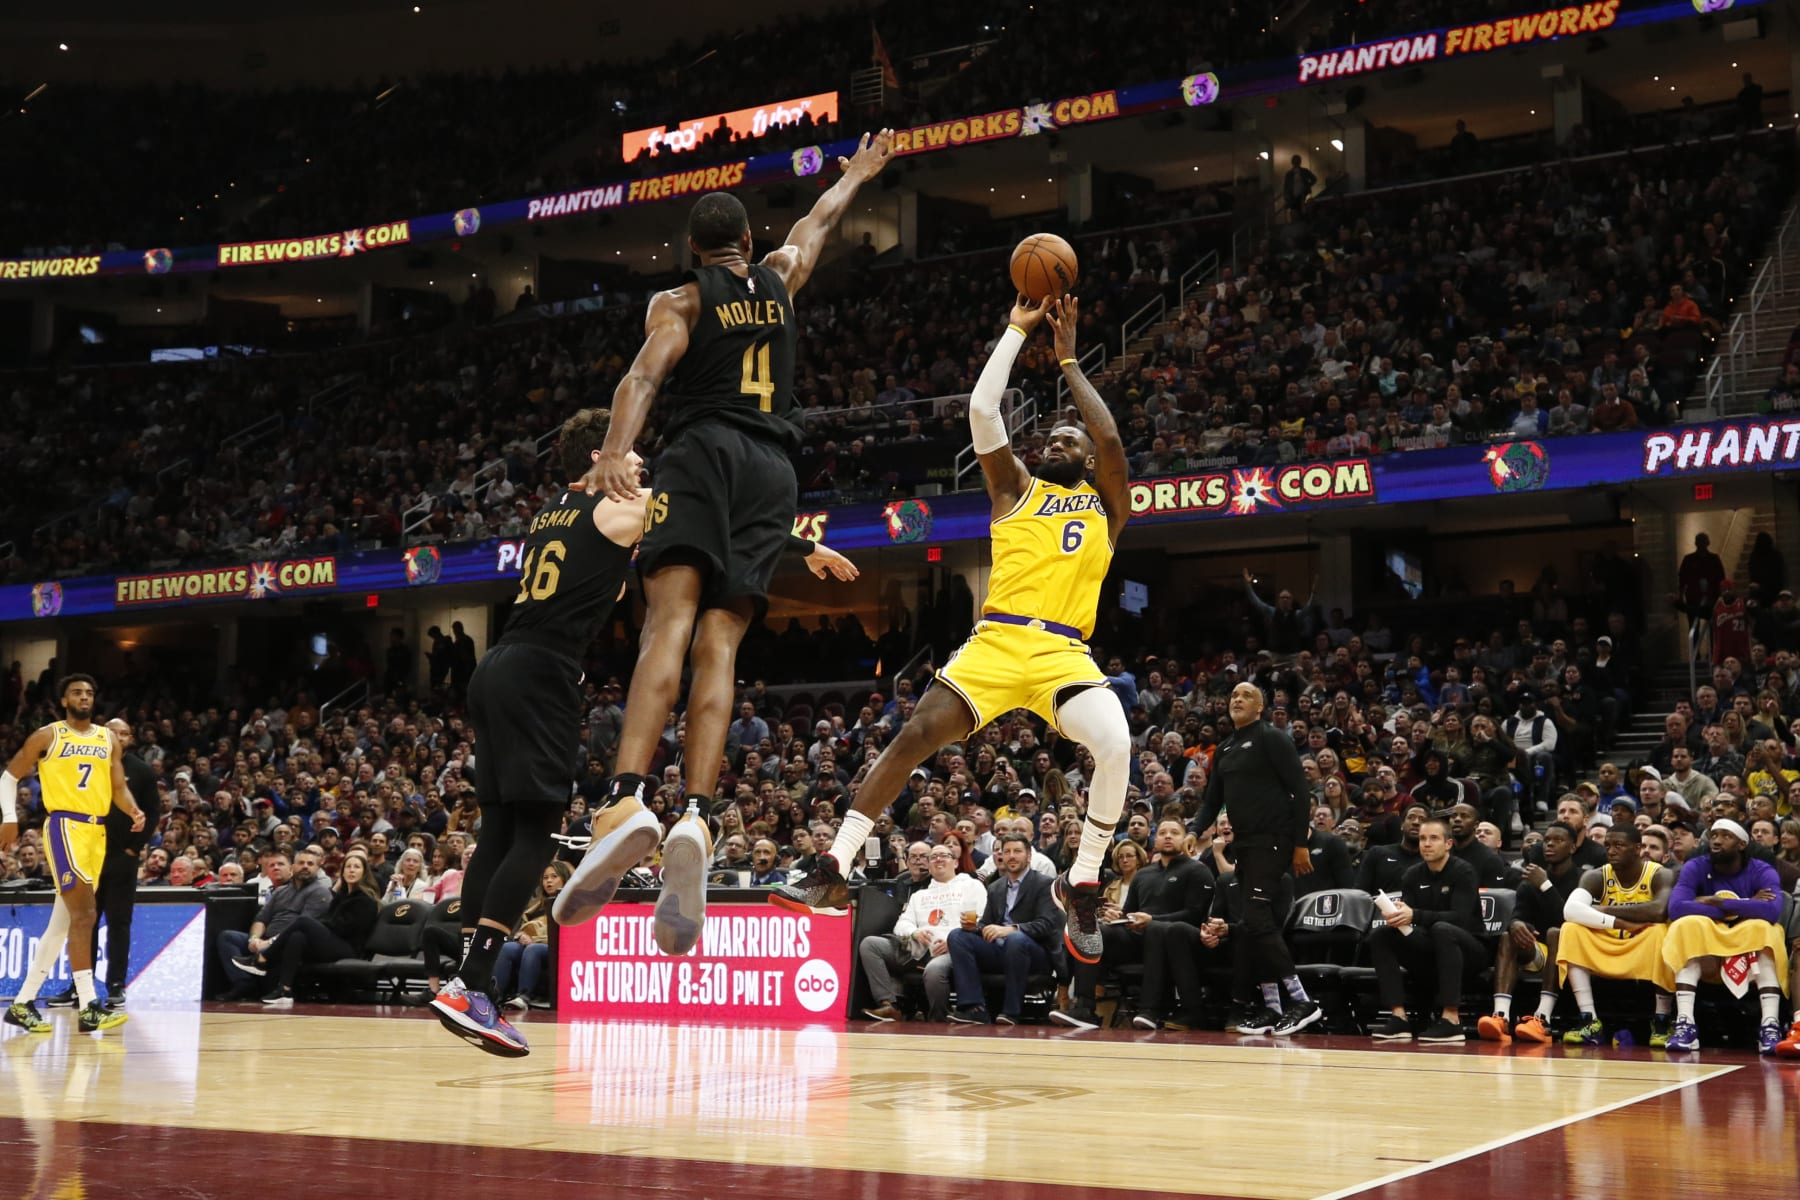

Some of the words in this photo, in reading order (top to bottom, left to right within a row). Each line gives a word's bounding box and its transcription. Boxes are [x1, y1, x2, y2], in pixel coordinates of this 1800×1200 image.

[1299, 34, 1437, 83] PHANTOM
[1444, 0, 1621, 56] FIREWORKS
[1055, 93, 1117, 123] COM
[527, 184, 624, 220] PHANTOM
[628, 161, 747, 203] FIREWORKS
[219, 235, 341, 264] FIREWORKS
[365, 221, 409, 246] COM
[715, 299, 785, 330] MOBLEY
[739, 340, 775, 413] 4
[1280, 463, 1370, 499] COM
[529, 509, 582, 535] OSMAN
[1061, 519, 1085, 554] 6
[116, 569, 248, 602] FIREWORKS
[279, 559, 335, 587] COM
[513, 539, 567, 604] 16
[58, 741, 108, 759] LAKERS
[77, 763, 93, 790] 7
[595, 915, 668, 957] CELTIC
[702, 915, 811, 959] WARRIORS
[570, 960, 673, 1004] SATURDAY
[678, 962, 728, 1006] 8:30
[733, 970, 759, 1006] PM
[763, 970, 785, 1007] ET
[797, 974, 836, 993] abc
